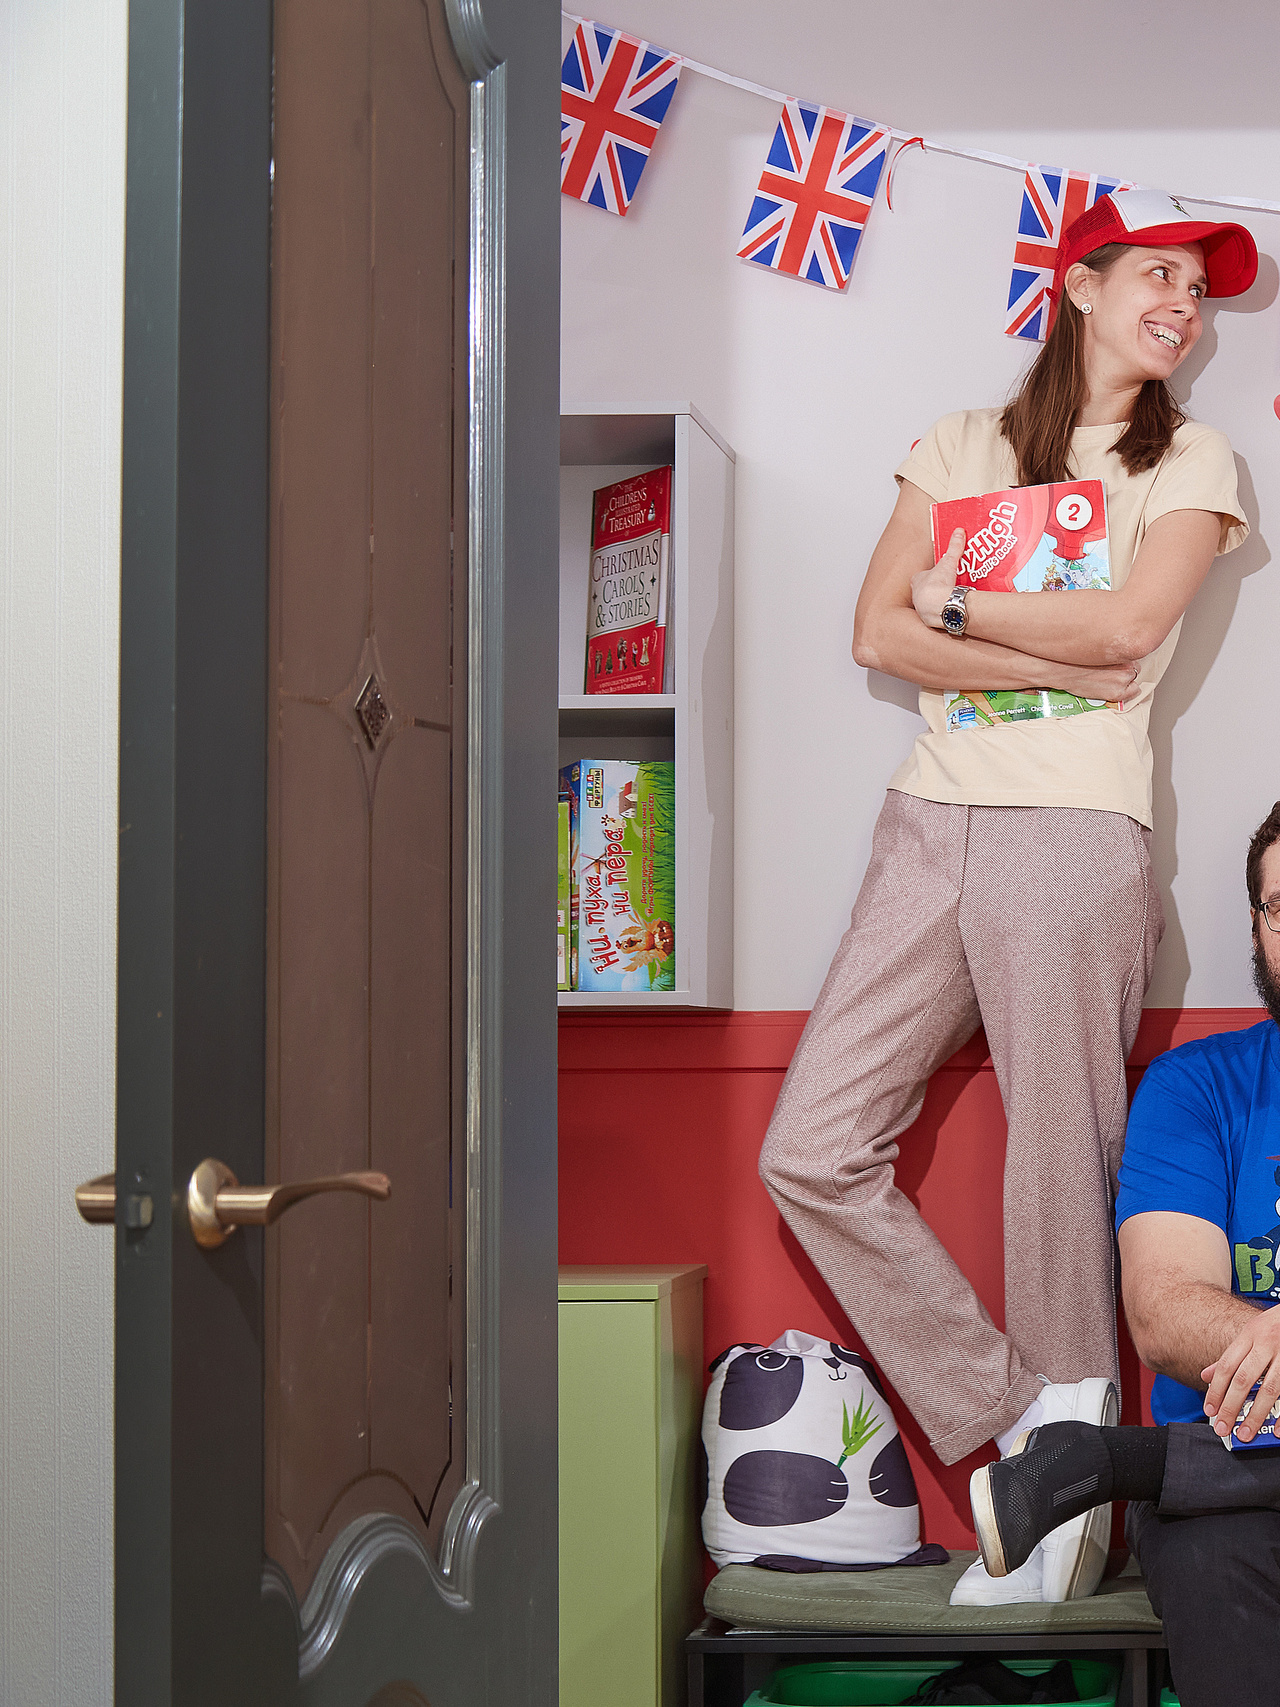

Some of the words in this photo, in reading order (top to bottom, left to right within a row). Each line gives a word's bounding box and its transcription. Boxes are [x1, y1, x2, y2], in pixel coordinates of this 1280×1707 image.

[608, 508, 647, 533] TREASURY
[1067, 503, 1081, 522] 2
[592, 538, 660, 582] CHRISTMAS
[969, 555, 1000, 581] Pupil's
[995, 535, 1018, 559] Book
[602, 571, 645, 604] CAROLS
[595, 604, 606, 628] &
[607, 592, 651, 624] STORIES
[604, 827, 632, 888] пера
[583, 874, 609, 926] пуха
[612, 890, 631, 917] ни
[588, 933, 620, 975] Ни
